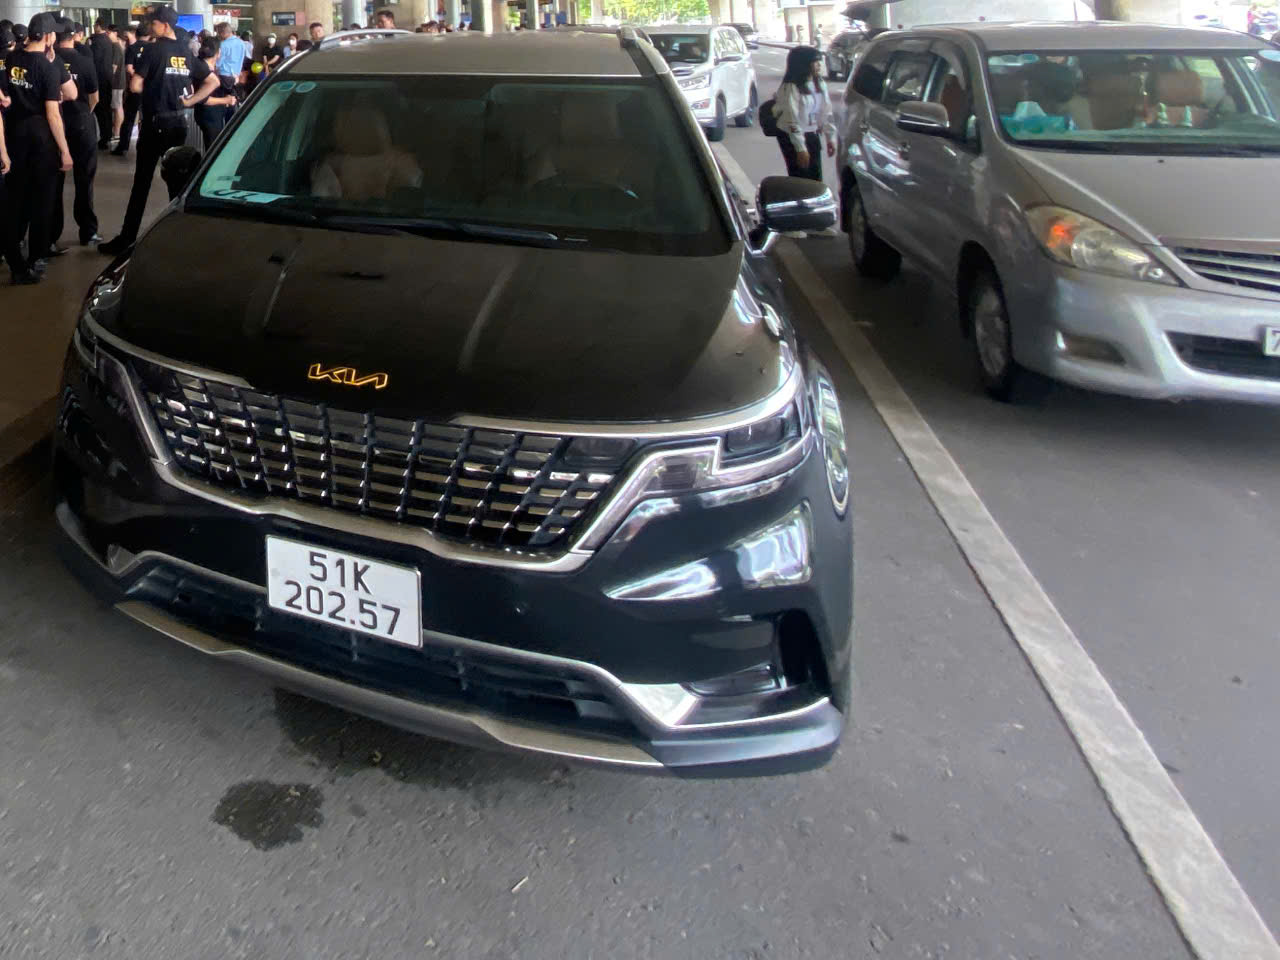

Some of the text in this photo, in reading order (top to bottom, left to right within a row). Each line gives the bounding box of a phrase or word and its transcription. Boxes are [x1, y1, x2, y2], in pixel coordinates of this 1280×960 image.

[170, 56, 187, 69] GE
[309, 551, 373, 596] 51K
[284, 580, 401, 636] 202.57
